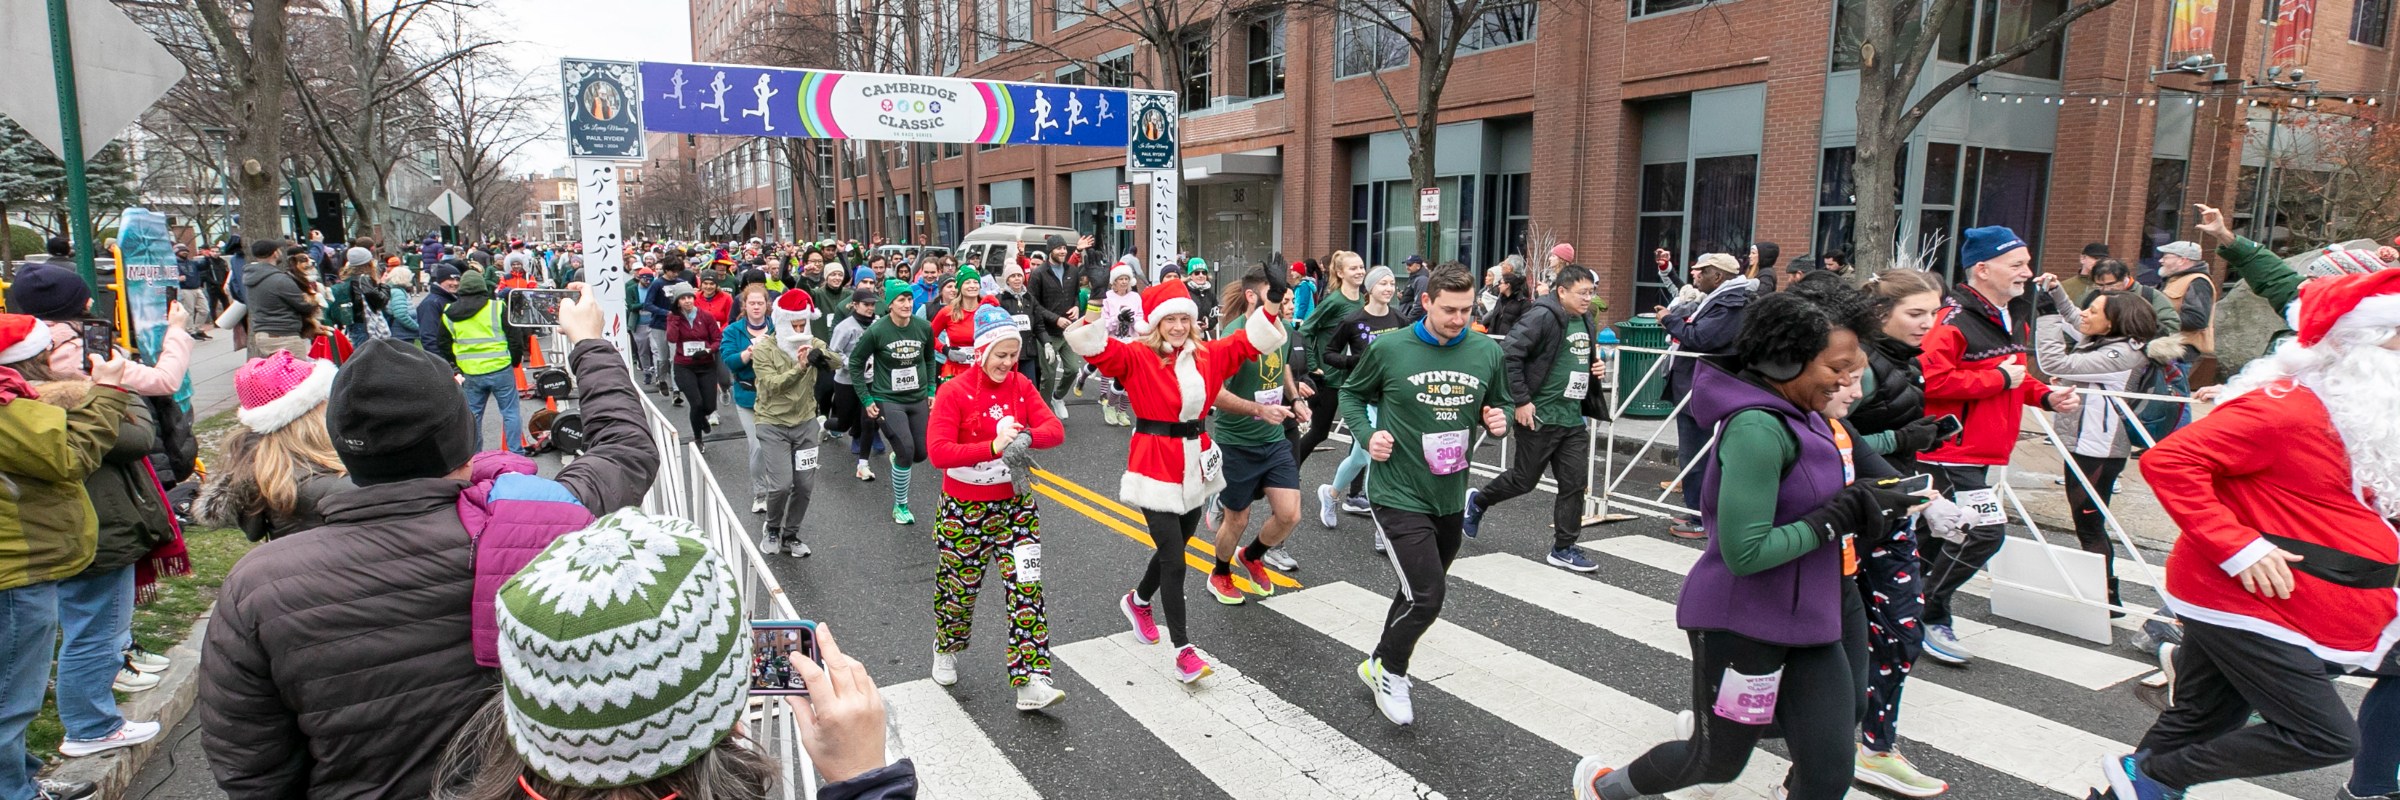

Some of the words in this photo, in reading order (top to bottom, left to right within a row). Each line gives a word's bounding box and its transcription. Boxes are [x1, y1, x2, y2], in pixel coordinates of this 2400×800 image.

[862, 83, 957, 103] CAMBRIDGE
[1233, 188, 1245, 203] 38
[887, 340, 921, 349] WINTER
[891, 350, 921, 359] CLASSIC
[544, 380, 566, 389] MYLAPS
[896, 375, 915, 384] 2409
[1407, 370, 1480, 390] WINTER
[1428, 384, 1441, 394] 5K
[1416, 392, 1475, 406] CLASSIC
[1436, 412, 1457, 420] 2024
[1436, 445, 1462, 460] 308
[1966, 502, 1998, 514] 025
[1737, 692, 1776, 708] 639
